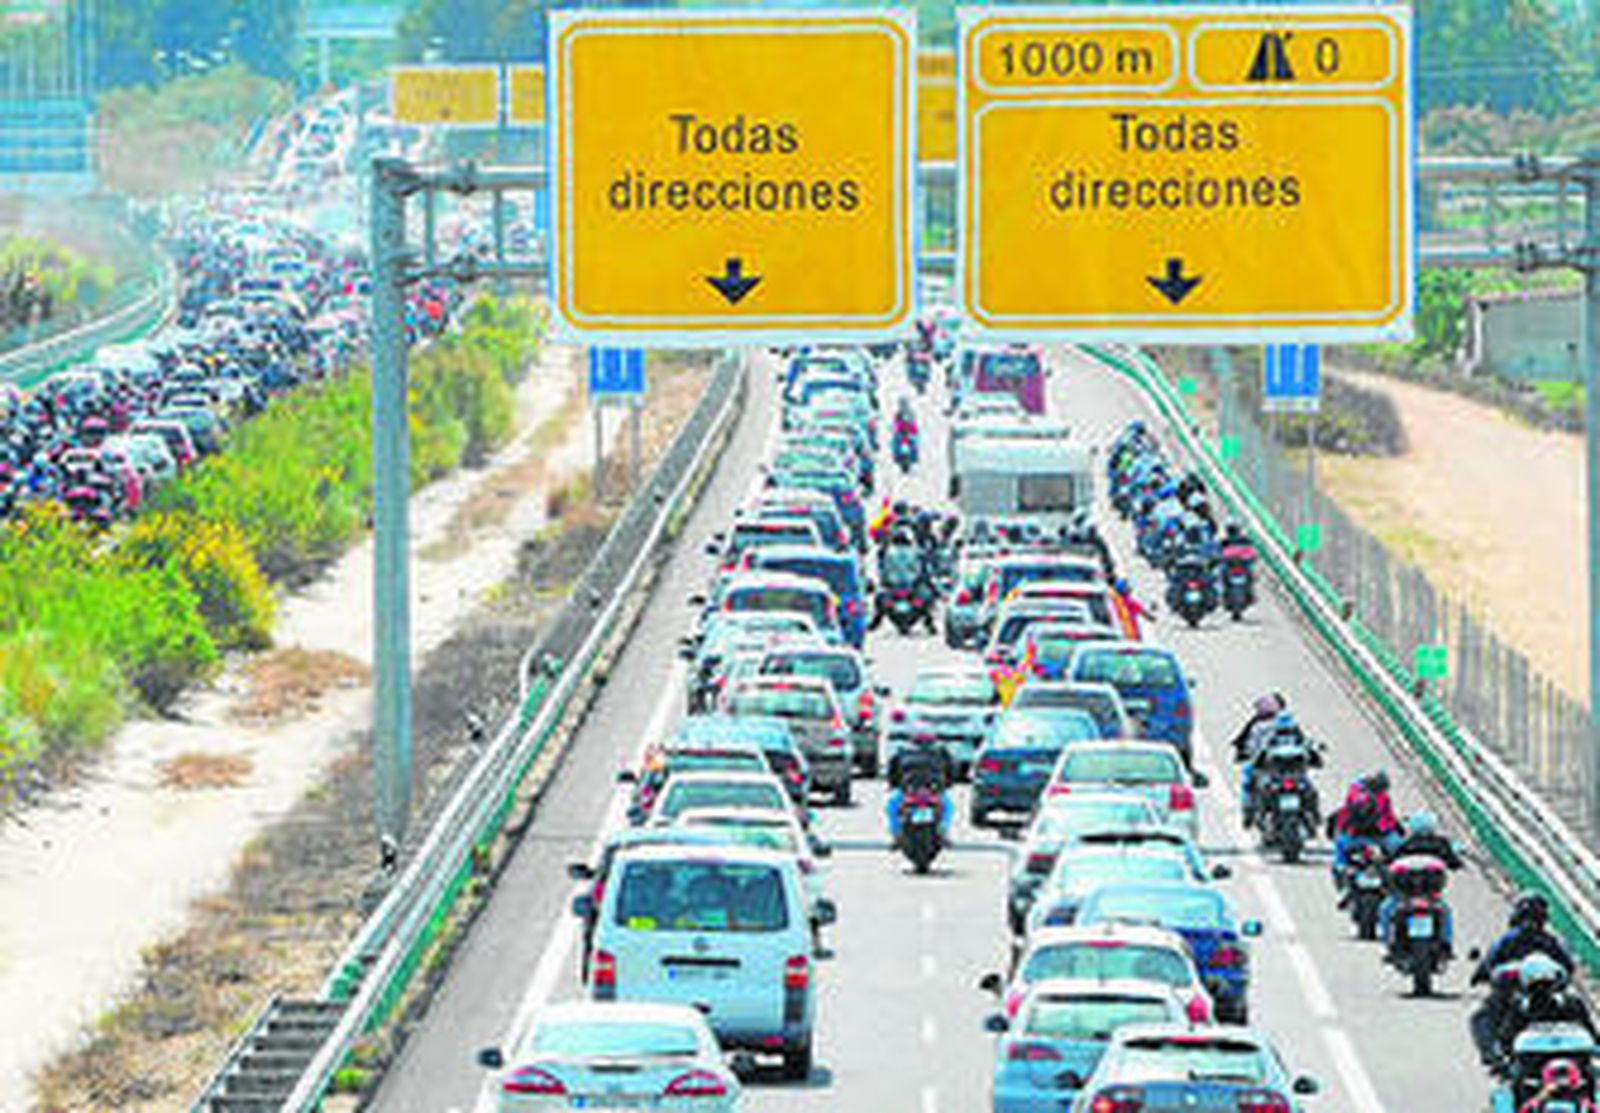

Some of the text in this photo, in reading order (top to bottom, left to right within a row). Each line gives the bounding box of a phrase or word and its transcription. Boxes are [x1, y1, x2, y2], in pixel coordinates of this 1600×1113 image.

[999, 41, 1154, 77] 1000 m
[672, 114, 799, 155] Todas
[1111, 112, 1239, 153] Todas
[608, 172, 860, 212] direcciones
[1050, 171, 1301, 211] direcciones
